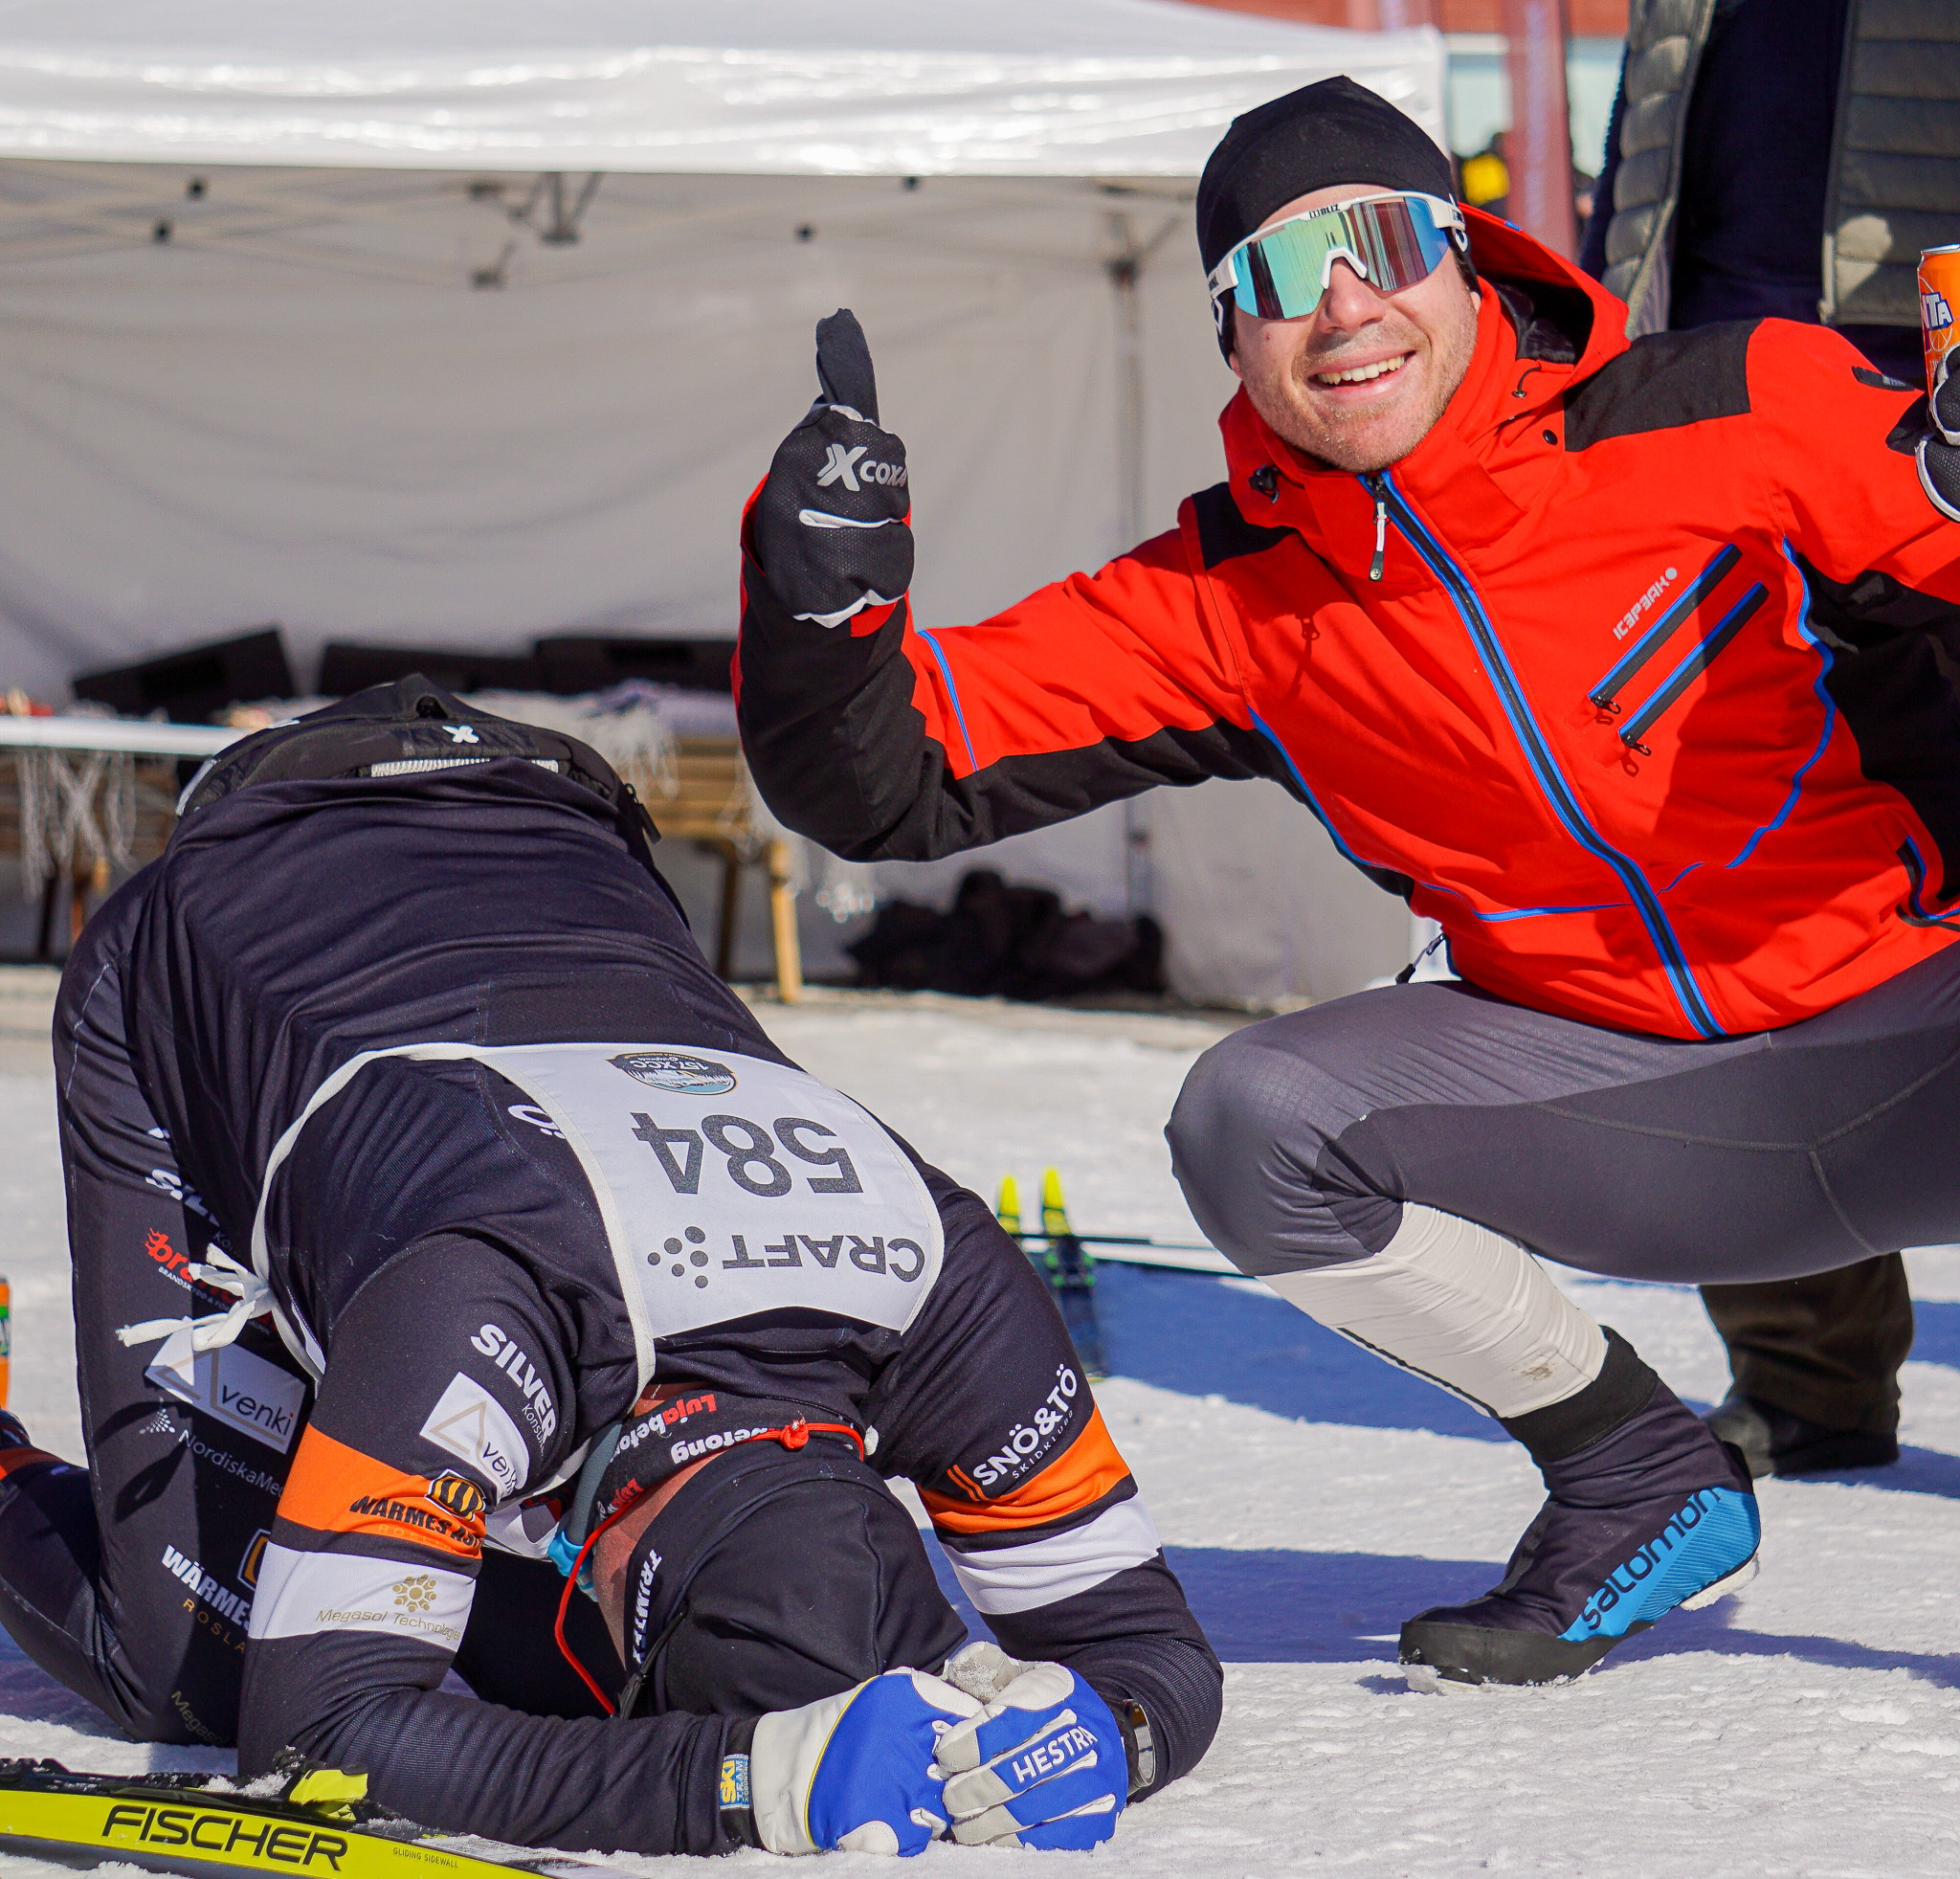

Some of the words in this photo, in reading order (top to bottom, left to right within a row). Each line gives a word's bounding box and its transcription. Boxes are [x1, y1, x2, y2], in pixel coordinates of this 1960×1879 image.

[1321, 204, 1341, 215] BLIZ
[630, 1112, 864, 1197] 584
[722, 1234, 925, 1283] CRAFT
[470, 1323, 557, 1443] SILVER
[972, 1363, 1078, 1486] SNÖ&TÖ
[315, 1608, 389, 1622] Megasol
[393, 1612, 461, 1642] Technologies
[632, 1549, 663, 1665] TRIMTEX
[720, 1759, 736, 1803] SKI
[1012, 1725, 1099, 1783] HESTRA
[101, 1804, 349, 1871] FISCHER
[392, 1846, 422, 1861] GLIDING
[423, 1853, 459, 1868] SIDEWALL
